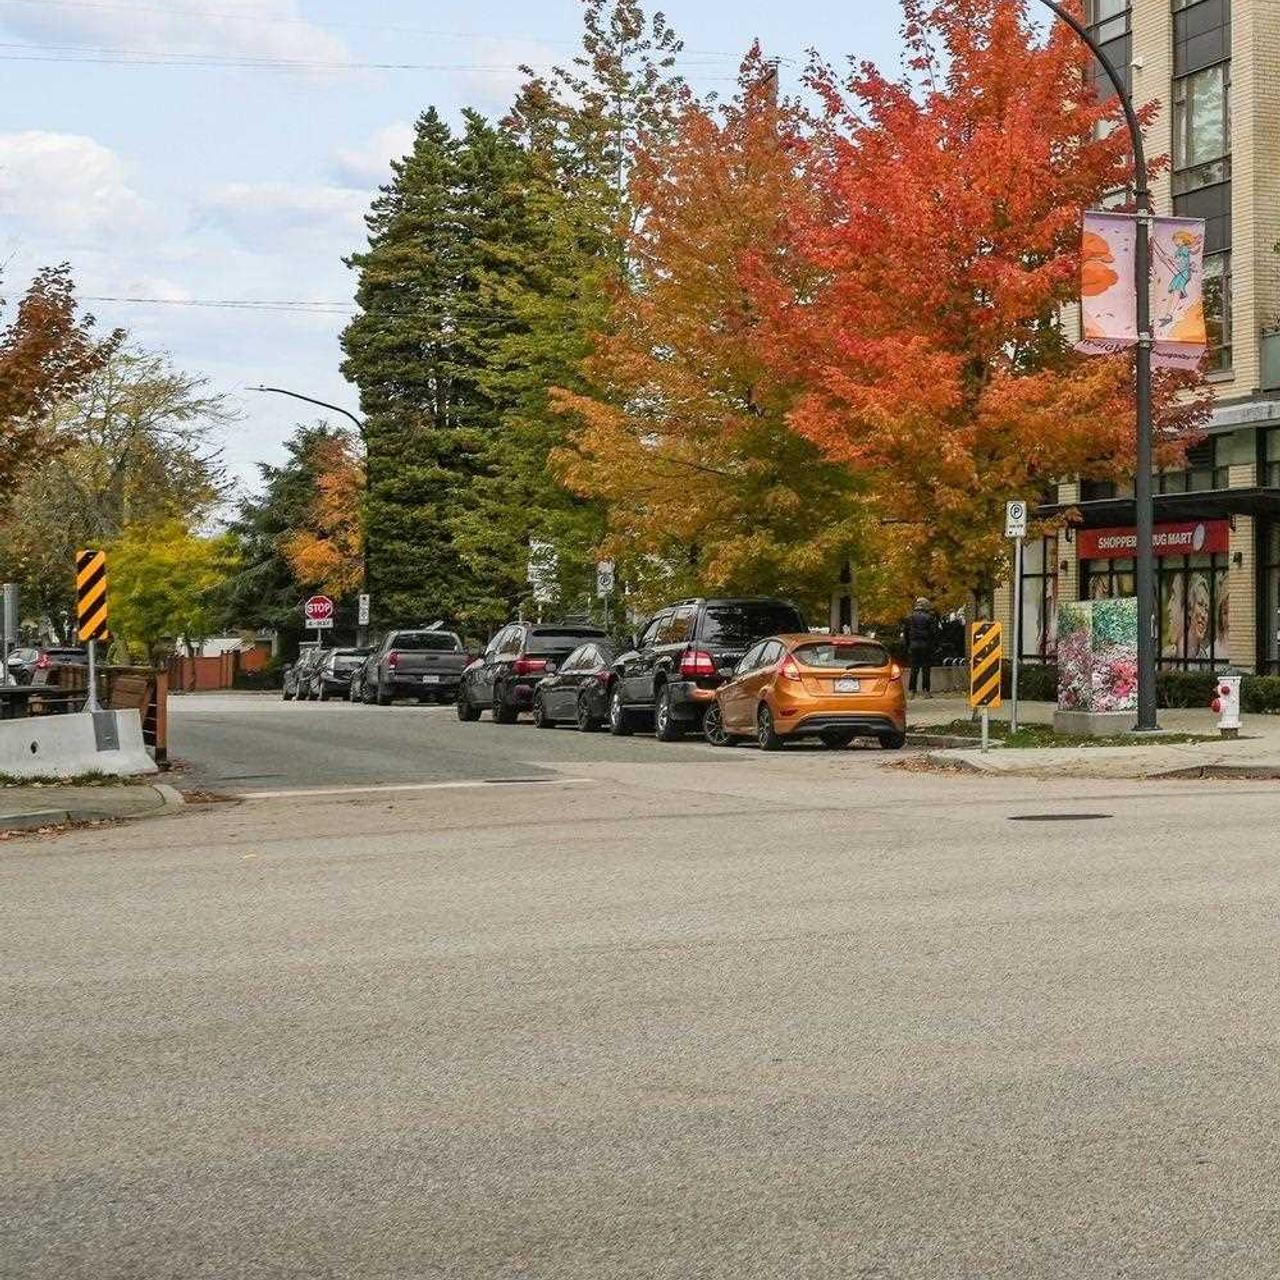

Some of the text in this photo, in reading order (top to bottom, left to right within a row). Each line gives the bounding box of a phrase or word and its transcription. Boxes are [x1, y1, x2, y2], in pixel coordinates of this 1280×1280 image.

[1098, 535, 1137, 548] SHOPPER
[1167, 532, 1193, 545] MART
[307, 602, 331, 613] STOP
